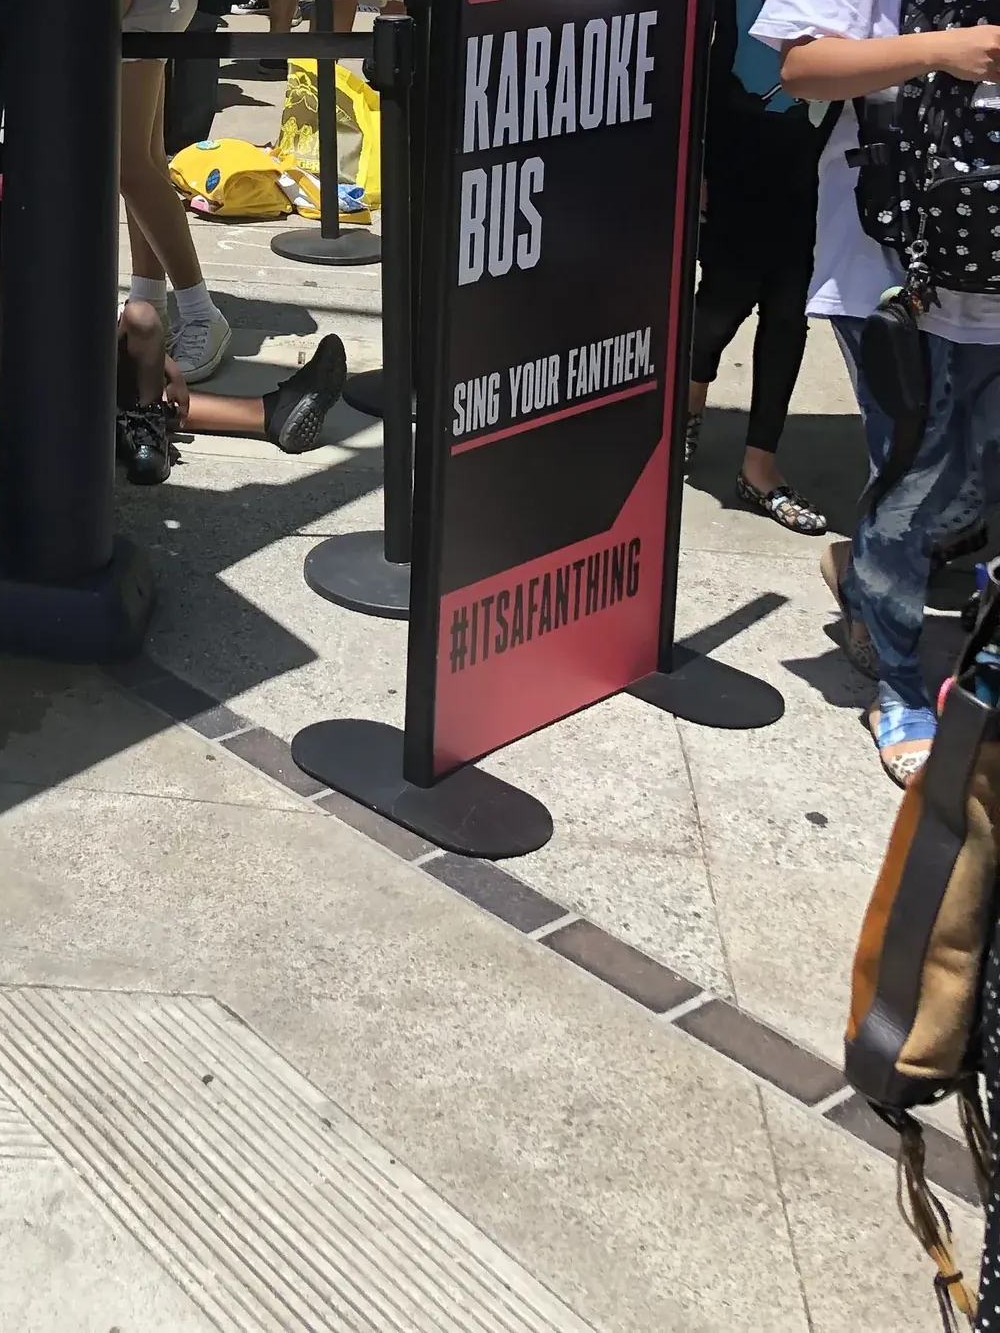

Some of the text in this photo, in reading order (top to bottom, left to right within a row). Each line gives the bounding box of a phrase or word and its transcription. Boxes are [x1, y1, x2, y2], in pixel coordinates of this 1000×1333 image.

[462, 10, 659, 154] KARAOKE
[457, 156, 546, 287] BUS
[452, 326, 656, 438] SING YOUR FANTHEM.
[449, 536, 643, 674] #ITSAFANTHING
